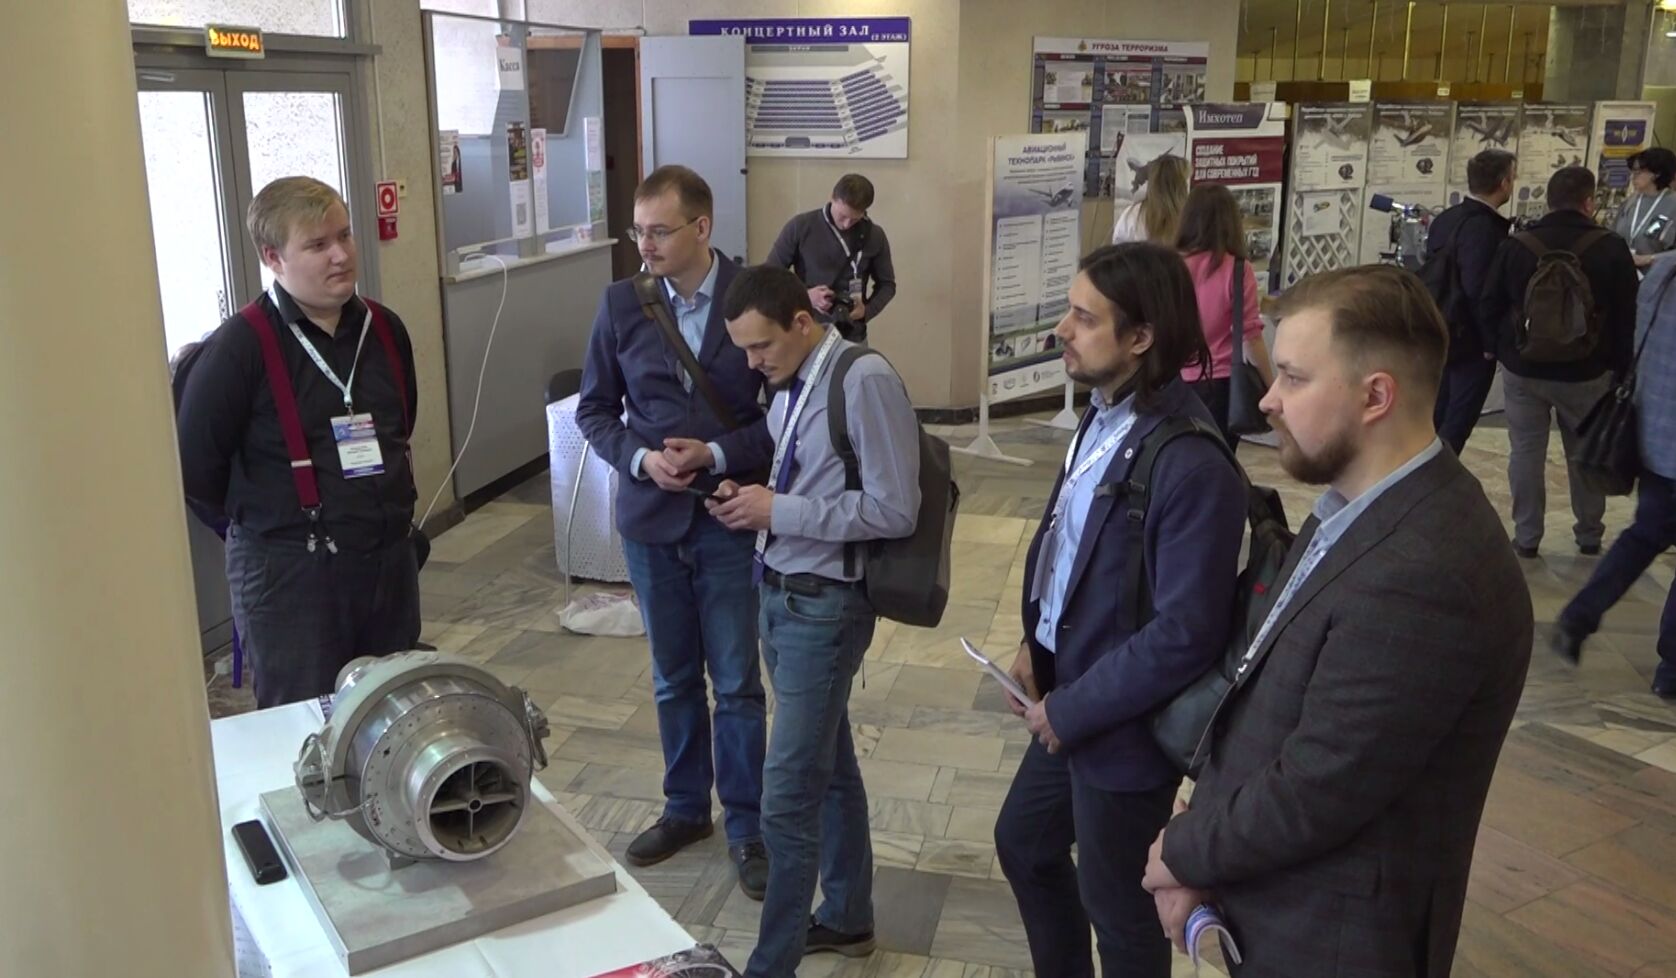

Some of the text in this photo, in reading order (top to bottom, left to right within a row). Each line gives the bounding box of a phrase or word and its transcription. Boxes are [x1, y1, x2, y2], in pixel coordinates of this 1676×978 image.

[720, 24, 833, 38] КОНЦЕРТНЫЙ
[839, 25, 869, 37] ЗАЛ
[209, 28, 260, 50] ВЫХОД
[1092, 43, 1169, 52] УГРОЗА ТЕРРОРИЗМА
[499, 59, 520, 73] Касса
[1198, 110, 1243, 124] Имхотеп
[1008, 155, 1046, 165] ТЕХНОПАРК
